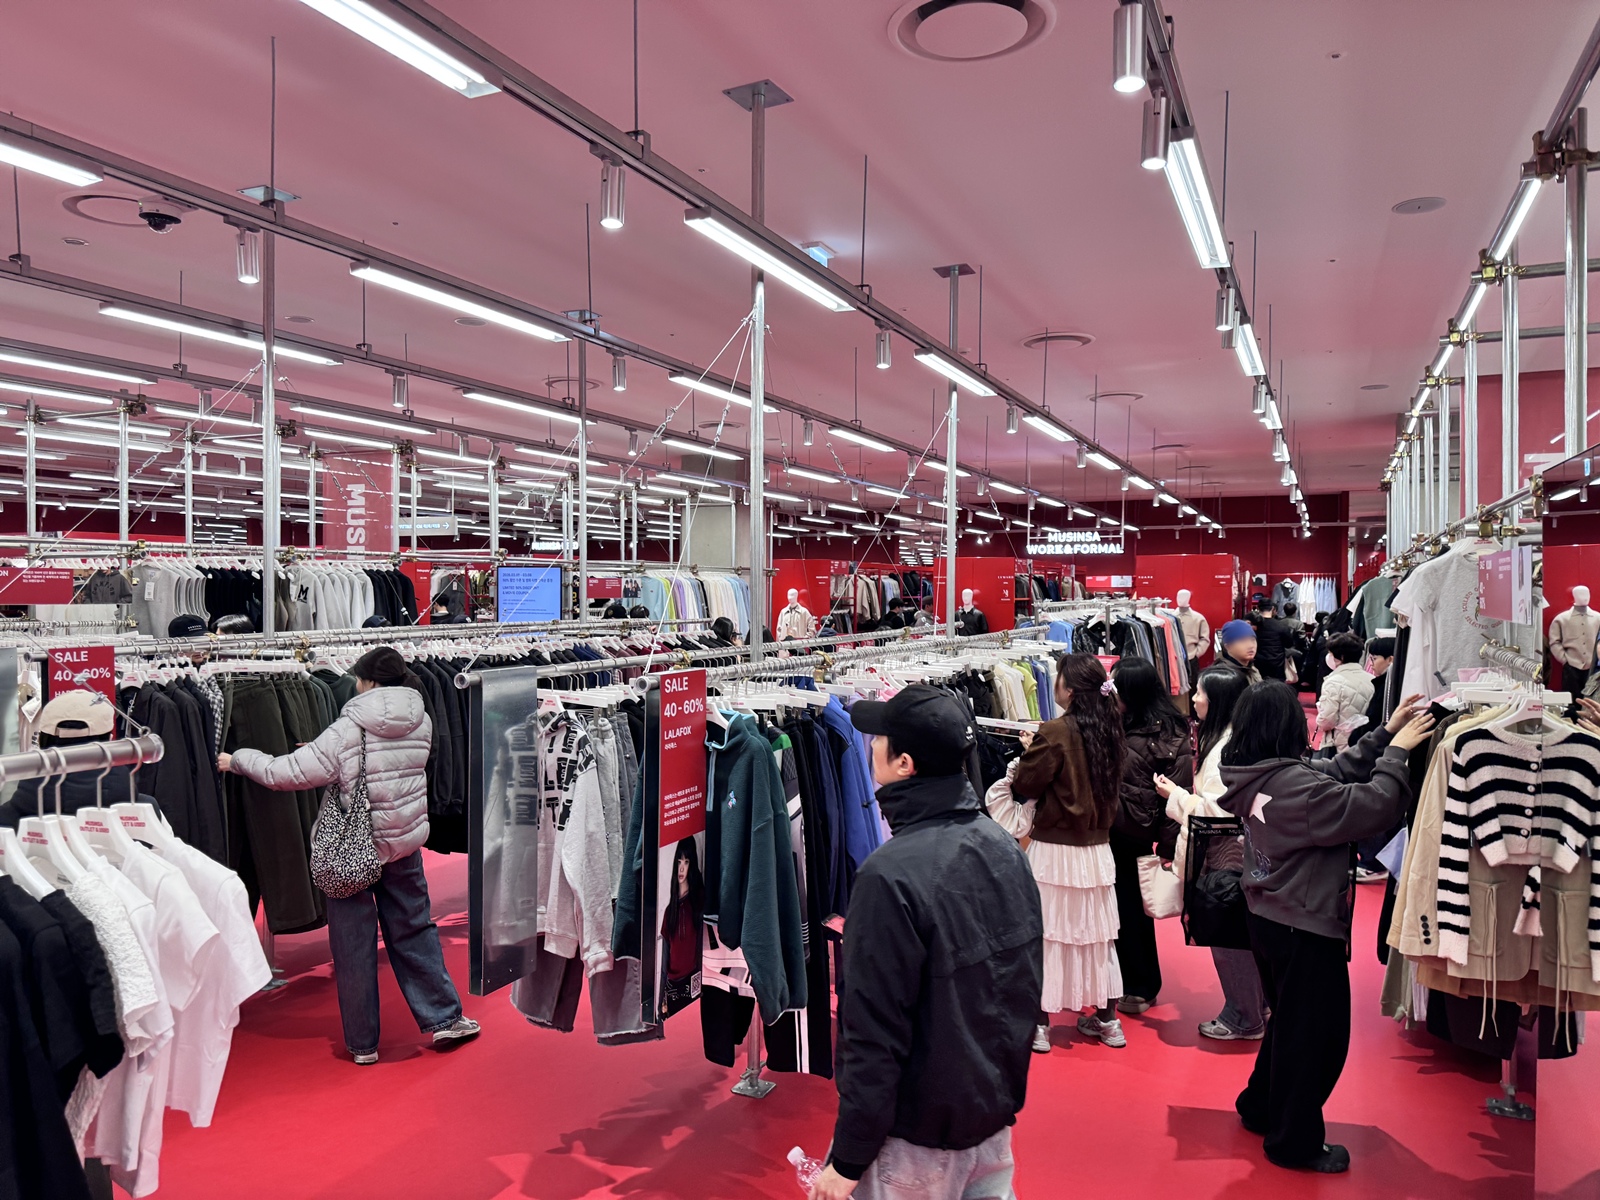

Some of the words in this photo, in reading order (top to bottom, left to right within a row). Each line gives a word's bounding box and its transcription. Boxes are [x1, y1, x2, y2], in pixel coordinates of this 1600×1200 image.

[1047, 531, 1101, 542] MUSINSA
[1026, 543, 1125, 555] WORK&FORMAL
[54, 650, 89, 663] SALE
[664, 676, 689, 693] SALE
[664, 725, 692, 740] LALAFOX
